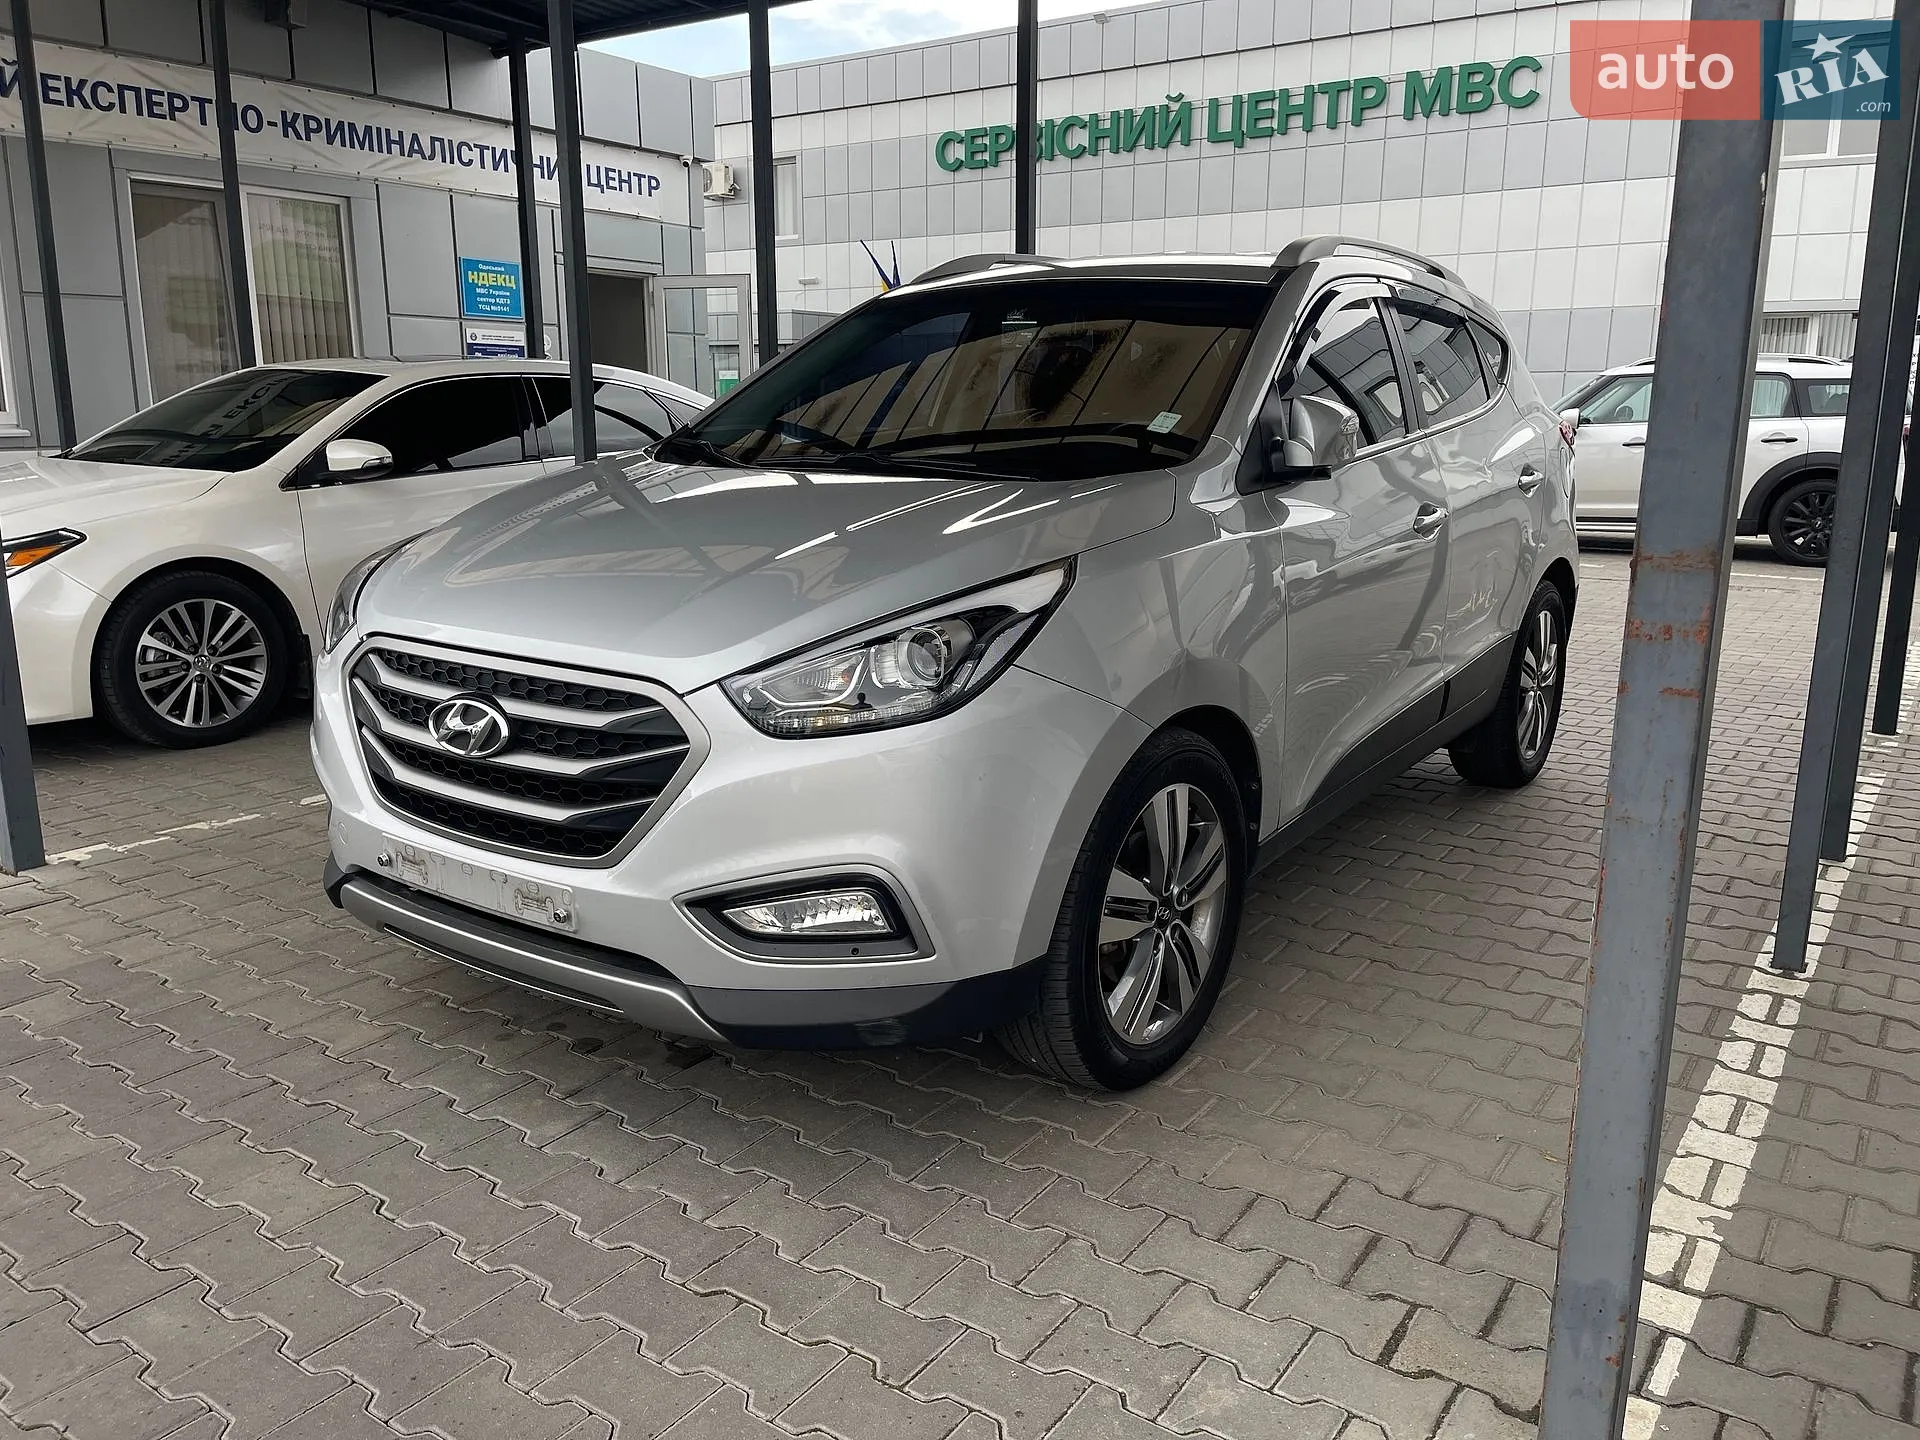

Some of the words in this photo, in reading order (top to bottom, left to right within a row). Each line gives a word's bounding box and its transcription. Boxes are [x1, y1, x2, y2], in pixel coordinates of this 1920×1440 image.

[39, 72, 563, 182] ЕКСПЕРТО-КРИМІНАЛІСТИНИ
[585, 164, 661, 198] ЦЕНТР
[1207, 76, 1388, 148] ЦЕНТР
[1402, 56, 1542, 121] МВС
[467, 271, 516, 290] НДЕКЦ
